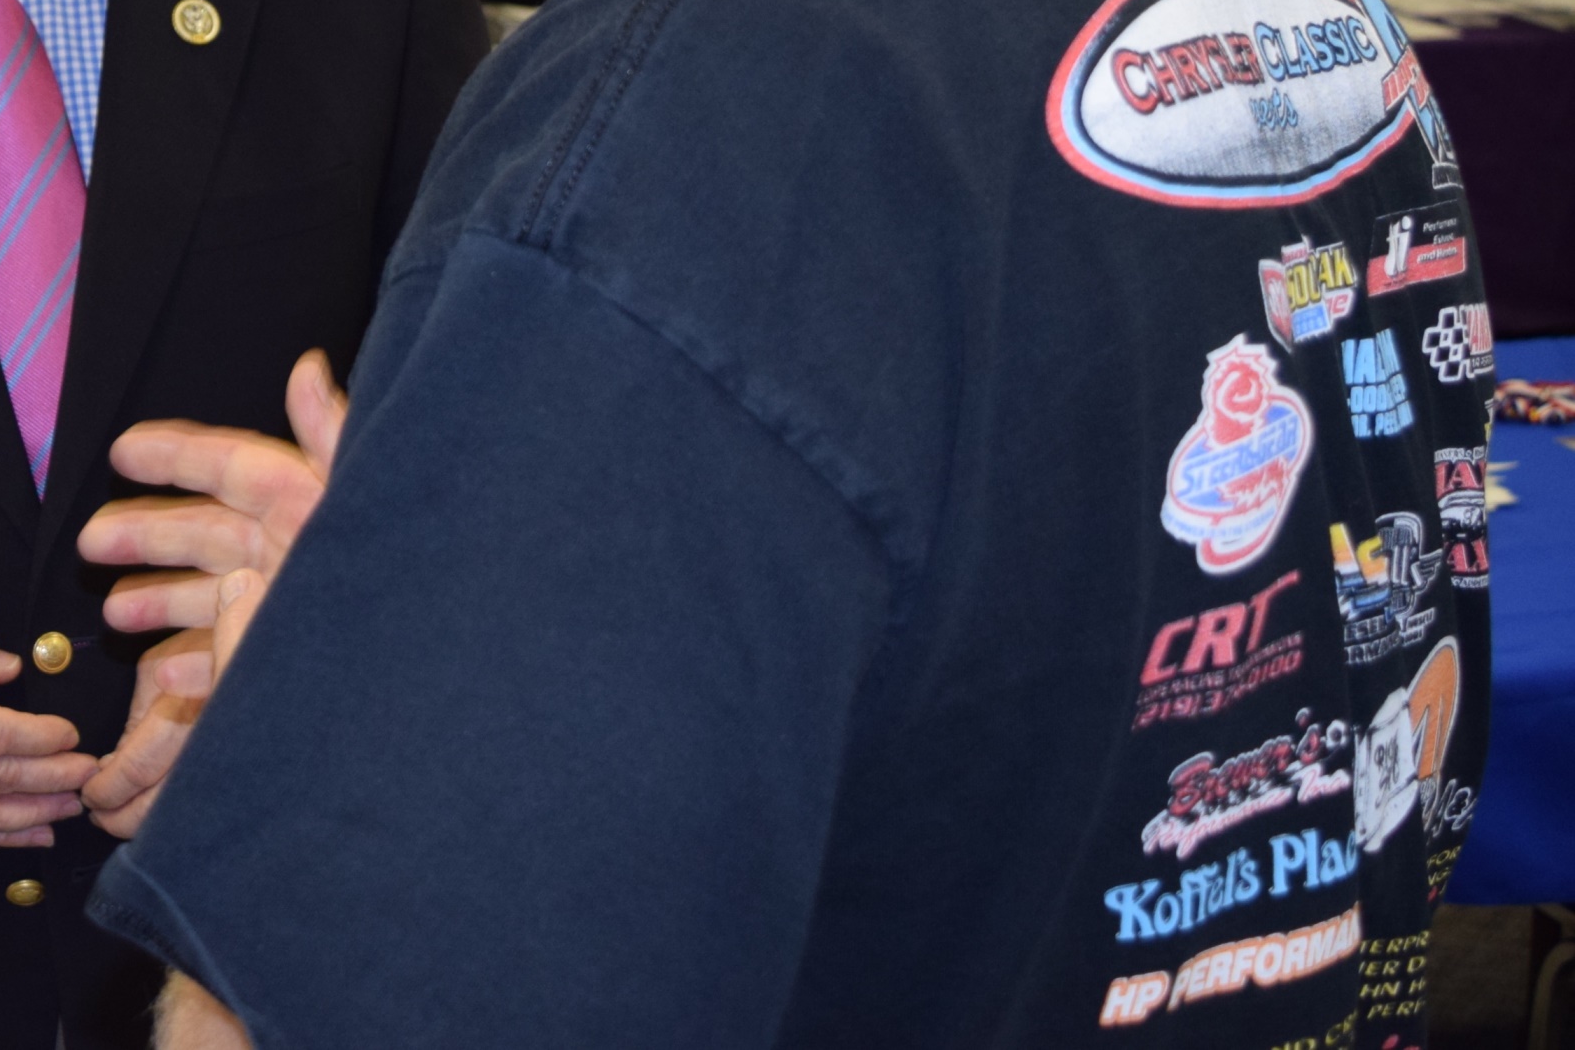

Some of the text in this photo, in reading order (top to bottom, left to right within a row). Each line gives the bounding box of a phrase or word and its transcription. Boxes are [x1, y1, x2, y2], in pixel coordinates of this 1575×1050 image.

[1111, 31, 1265, 115] CHRYSLER
[1254, 15, 1377, 81] CLASSIC
[1139, 569, 1302, 688] CRT
[1104, 846, 1261, 942] Koffel's
[1099, 970, 1170, 1028] HP
